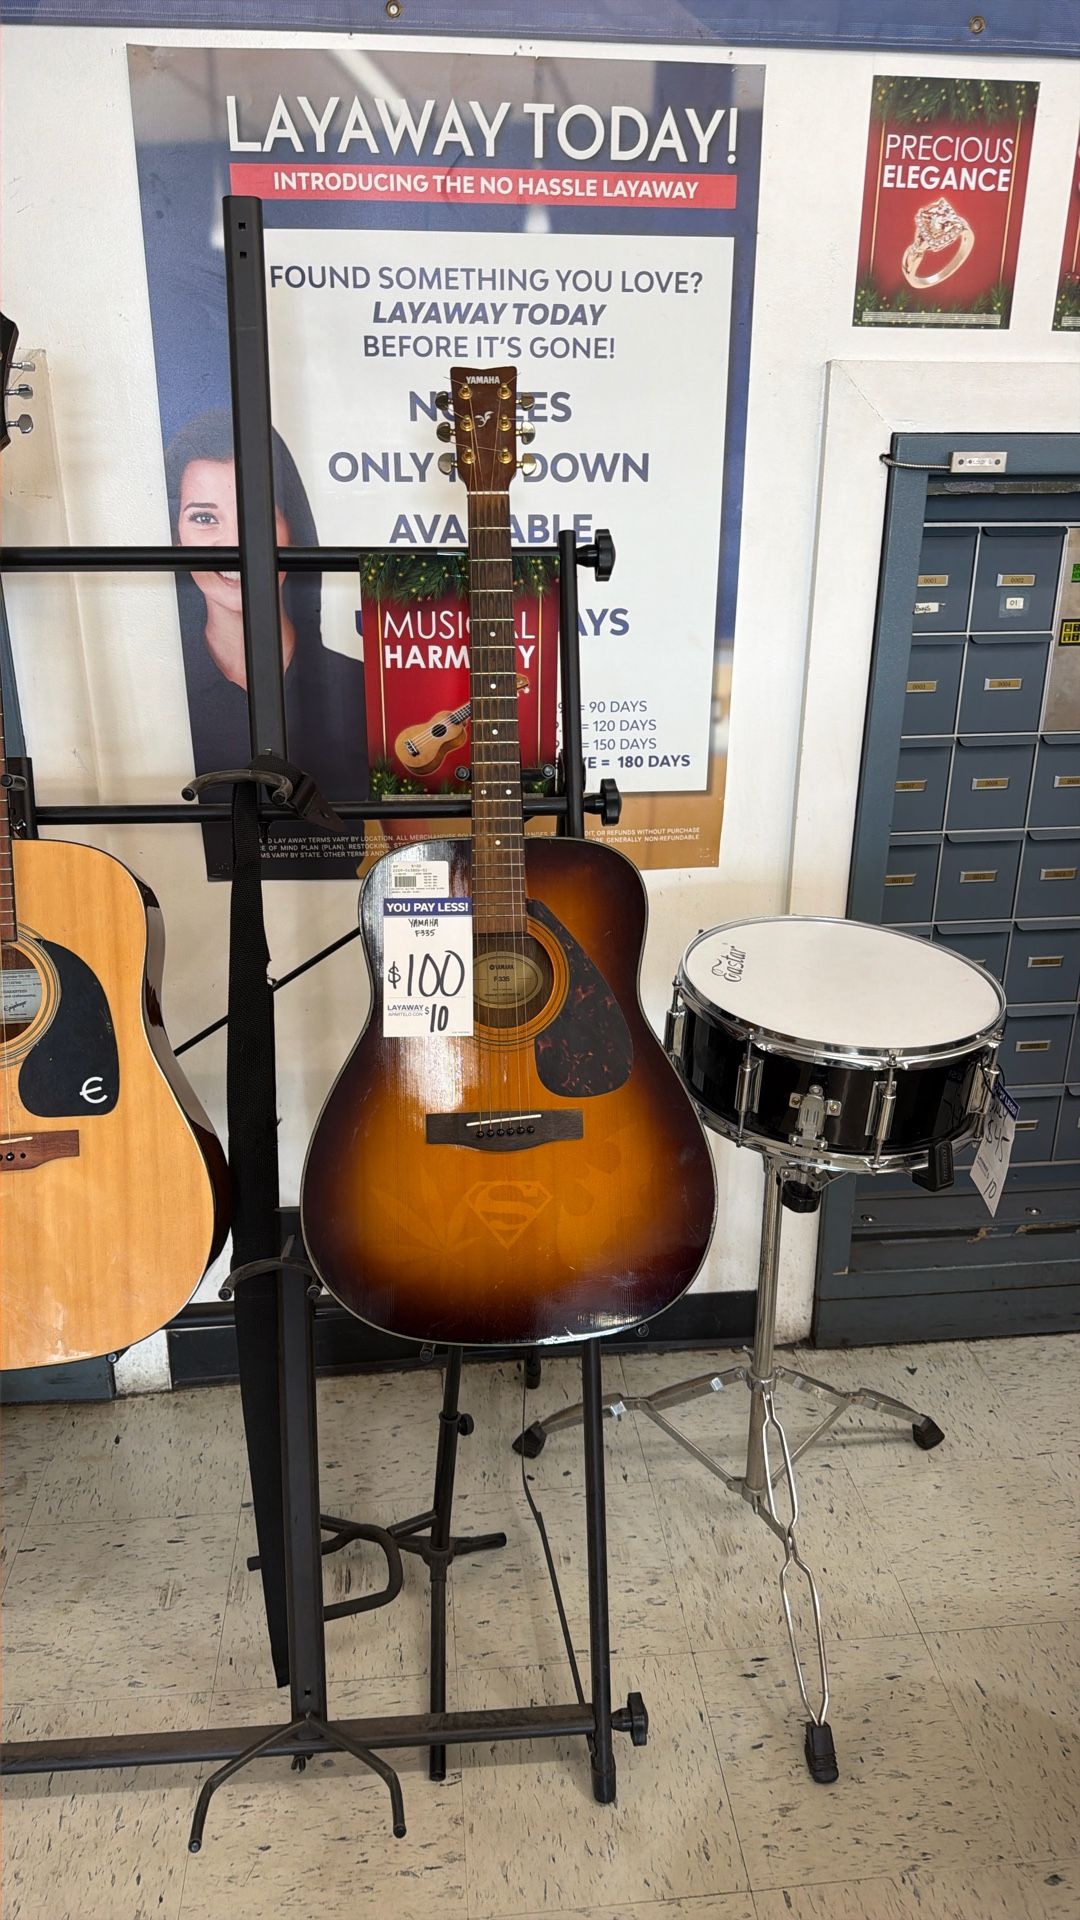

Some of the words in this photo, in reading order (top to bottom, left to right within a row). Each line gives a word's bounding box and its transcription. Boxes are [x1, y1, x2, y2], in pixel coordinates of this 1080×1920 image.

[226, 94, 511, 158] LAYAWAY
[523, 102, 738, 165] TODAY!
[885, 134, 1014, 164] PRECIOUS
[273, 171, 429, 193] INTRODUCING
[433, 175, 474, 194] THE
[480, 176, 513, 195] NO
[518, 177, 597, 197] HASSLE
[602, 180, 699, 200] LAYAWAY
[882, 165, 1011, 192] ELEGANCE
[270, 265, 371, 289] FOUND
[378, 266, 549, 292] SOMETHING
[555, 269, 613, 292] YOU
[621, 270, 703, 294] LOVE?
[372, 301, 508, 325] LAYAWAY
[512, 303, 608, 326] TODAY
[363, 335, 468, 358] BEFORE
[476, 336, 522, 358] IT'S
[529, 336, 615, 359] GONE!
[465, 375, 501, 385] YAMAHA
[328, 452, 434, 483] ONLY
[523, 452, 649, 483] DOWN
[389, 514, 593, 544] AVAABLE
[383, 610, 536, 639] MUSIL
[384, 645, 536, 669] HARMY
[589, 701, 606, 713] 90
[610, 700, 648, 713] DAYS
[593, 720, 616, 732] 120
[620, 719, 657, 731] DAYS
[593, 738, 616, 750] 150
[620, 738, 657, 750] DAYS
[617, 755, 644, 768] 180
[648, 755, 691, 768] DAYS
[386, 902, 411, 913] YOU
[413, 902, 435, 912] PAY
[437, 902, 469, 912] LESS!
[408, 918, 439, 928] YAMAHA
[415, 928, 436, 937] F335
[387, 950, 466, 997] $100
